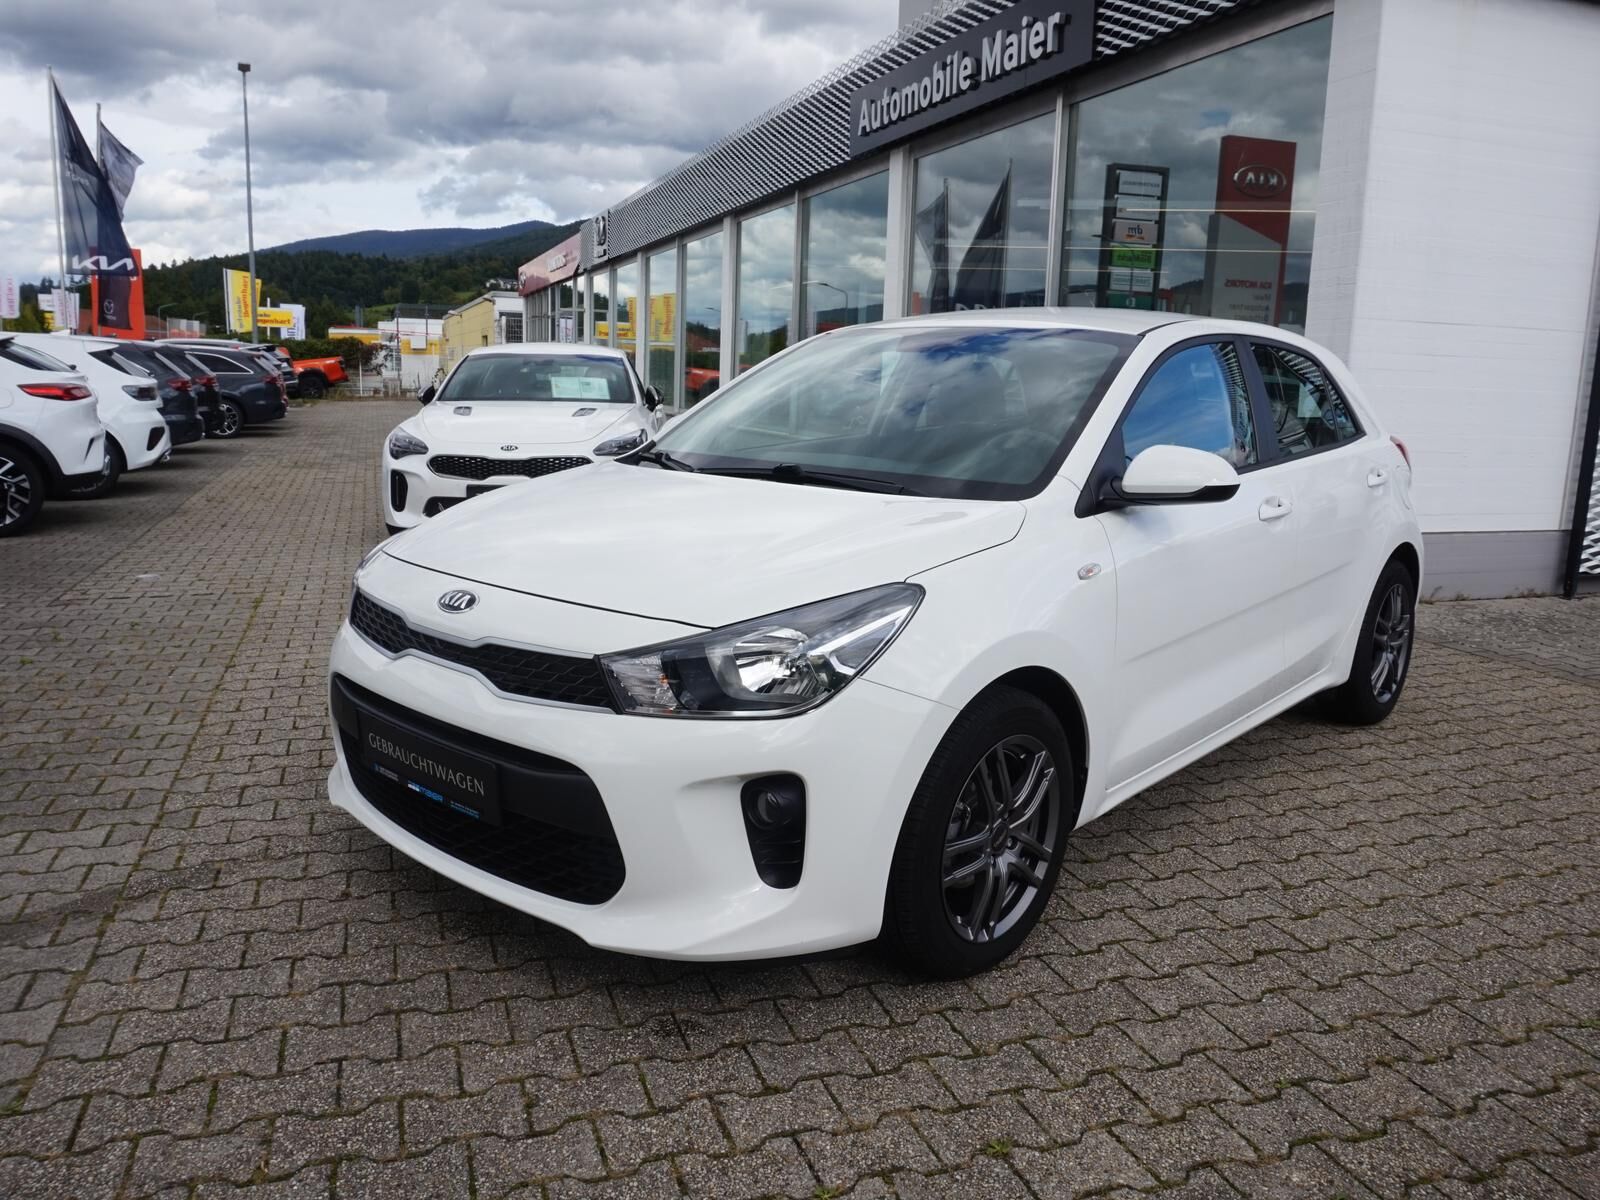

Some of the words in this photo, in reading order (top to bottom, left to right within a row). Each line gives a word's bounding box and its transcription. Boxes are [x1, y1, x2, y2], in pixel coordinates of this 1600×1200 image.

[857, 50, 975, 136] Automobile
[980, 11, 1063, 82] Maier
[440, 591, 471, 610] KIA
[368, 732, 485, 796] GEBRAUCHTWAGEN
